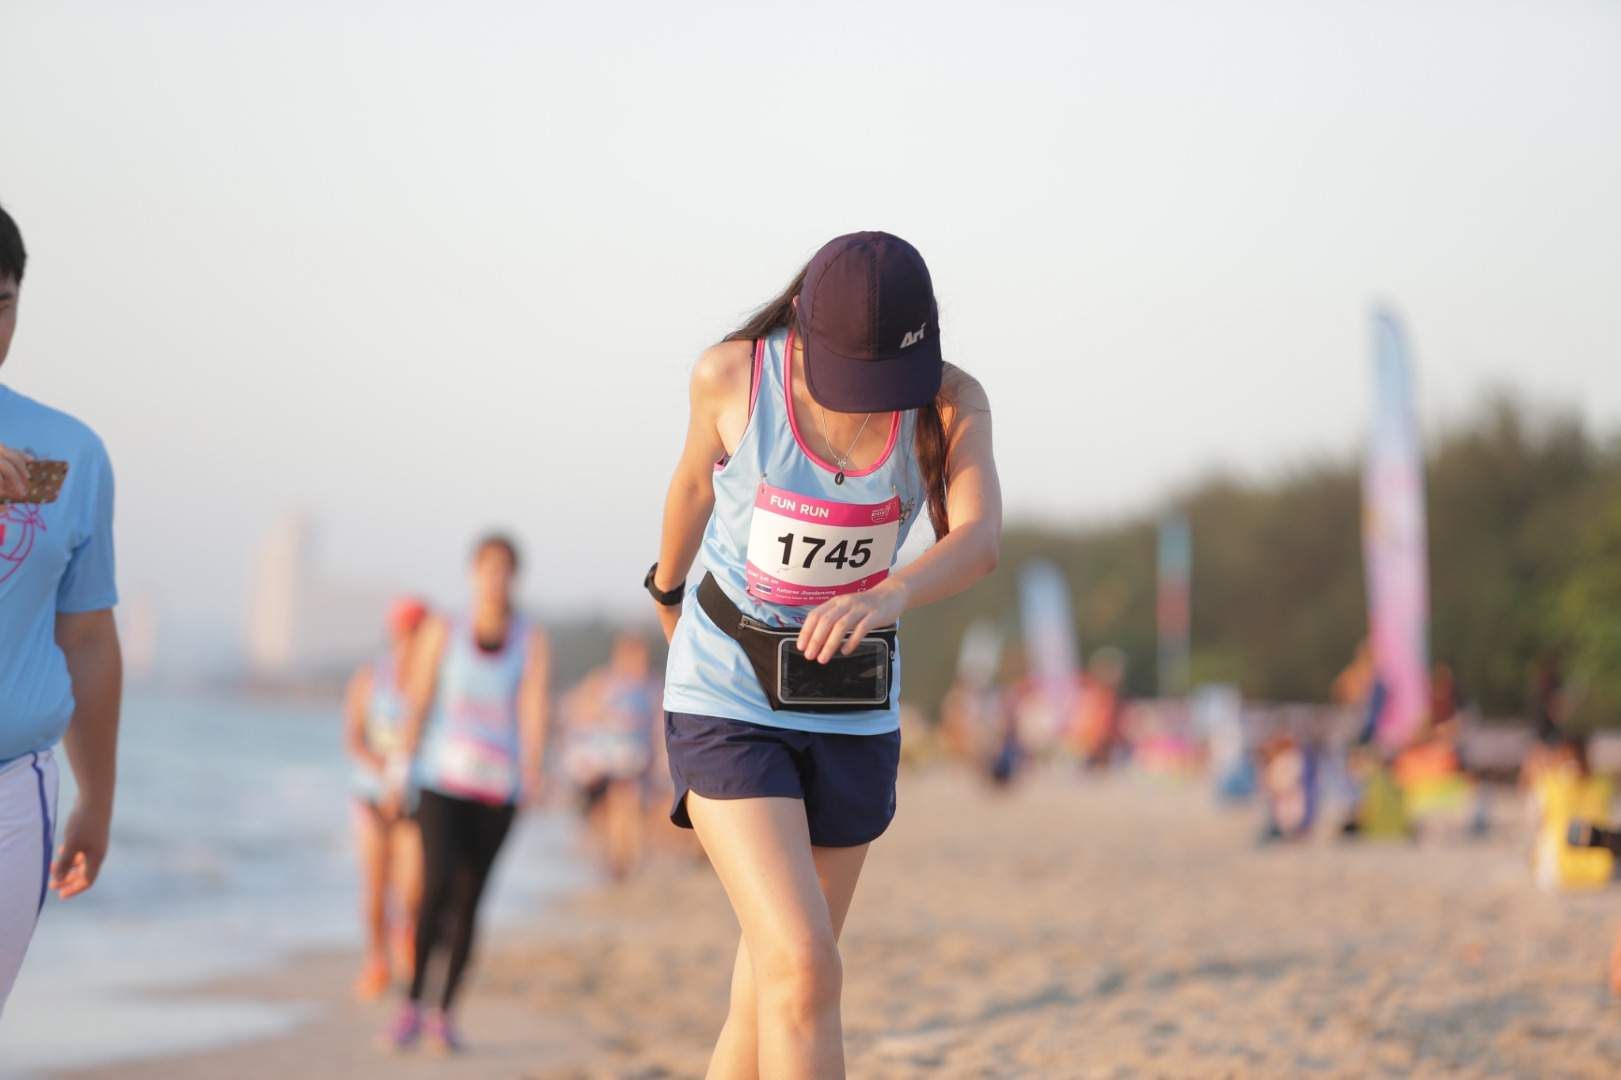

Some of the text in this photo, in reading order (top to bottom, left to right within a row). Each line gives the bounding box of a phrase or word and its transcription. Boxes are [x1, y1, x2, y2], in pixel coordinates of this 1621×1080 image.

[899, 322, 926, 349] Ari
[770, 495, 829, 519] FUN RUN
[777, 533, 874, 570] 1745
